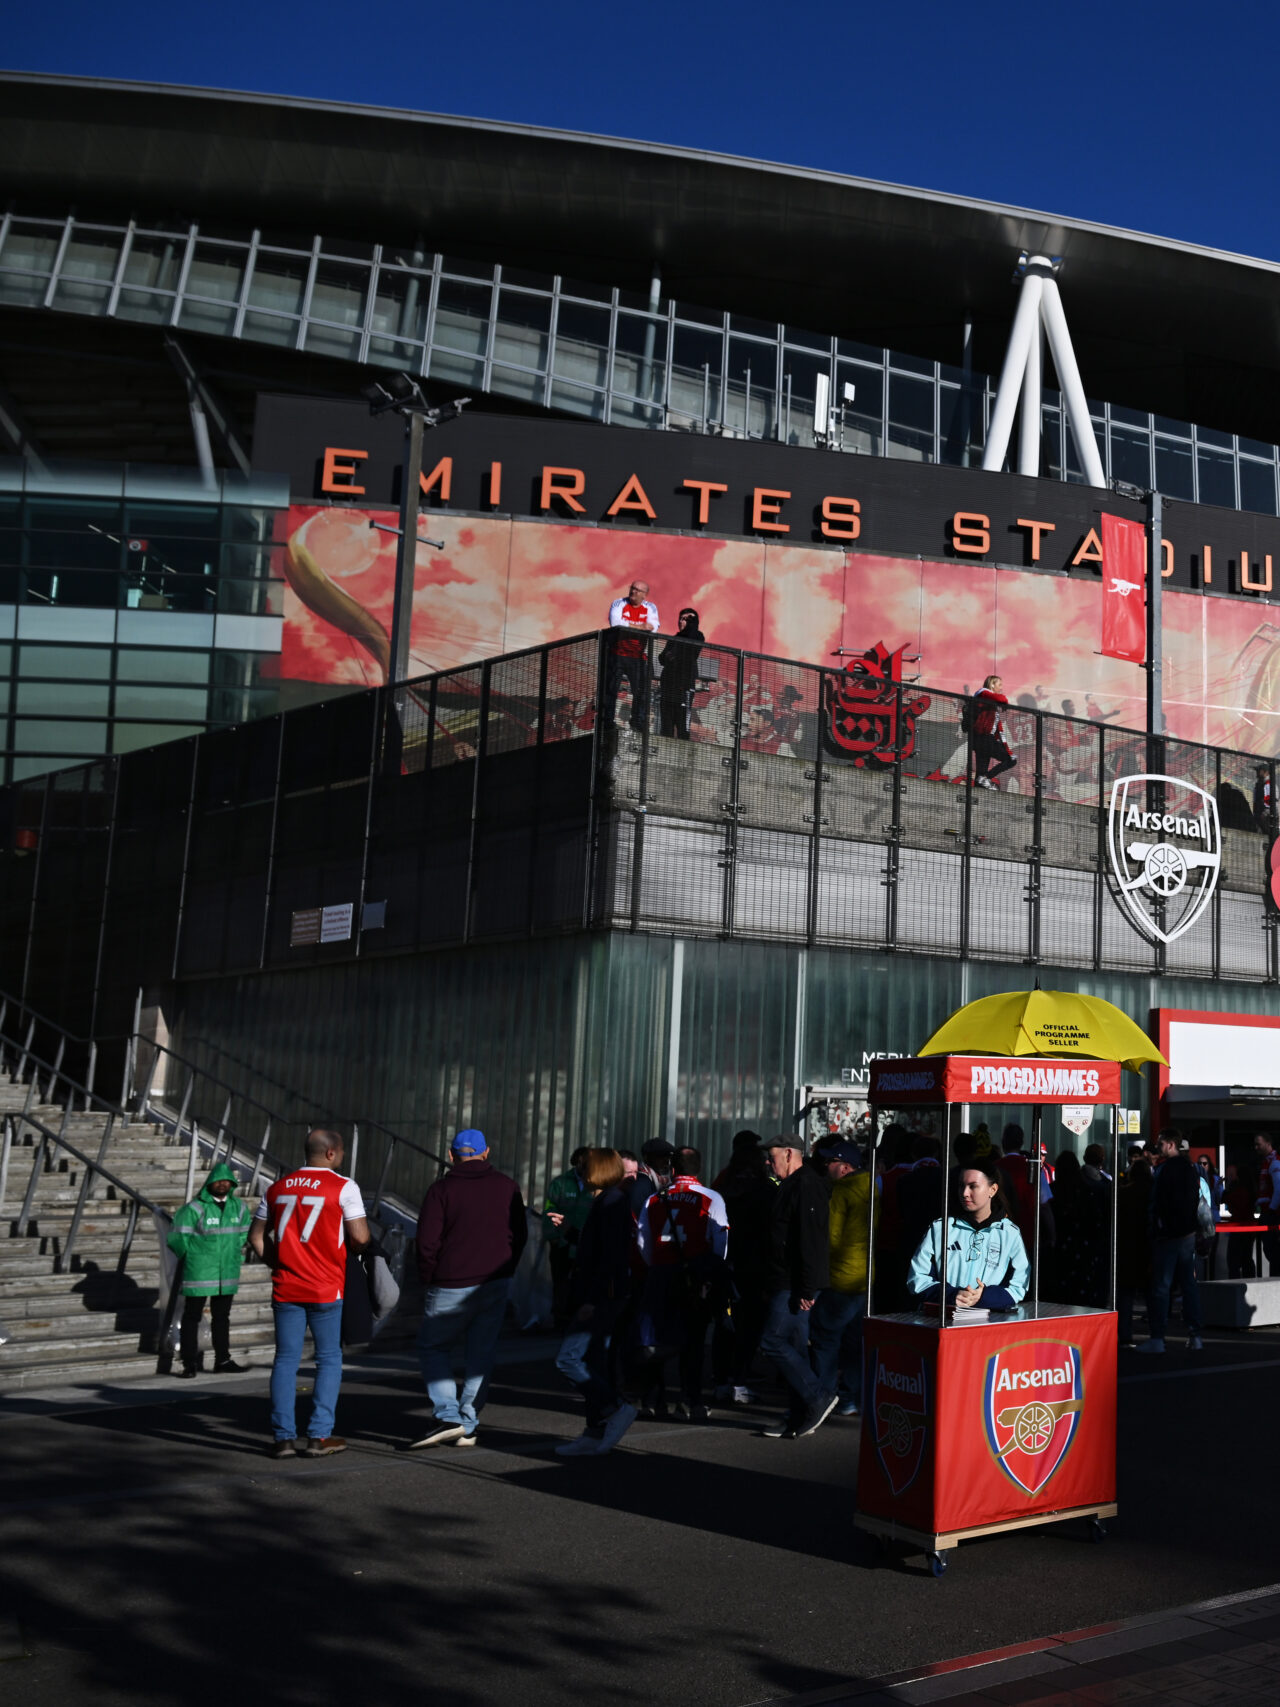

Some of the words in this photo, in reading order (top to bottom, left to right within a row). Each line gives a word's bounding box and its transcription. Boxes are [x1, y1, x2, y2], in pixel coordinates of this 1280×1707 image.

[321, 446, 861, 541] EMIRATES
[1125, 803, 1207, 839] Arsenal
[1034, 1030, 1091, 1039] PROGRAMME
[1042, 1023, 1080, 1031] OFFICIAL
[1048, 1039, 1079, 1047] SELLER
[970, 1065, 1100, 1097] PROGRAMMES
[286, 1177, 320, 1191] DIYAR
[274, 1194, 325, 1244] 77
[876, 1362, 923, 1396] Arsenal
[996, 1361, 1072, 1393] Arsenal
